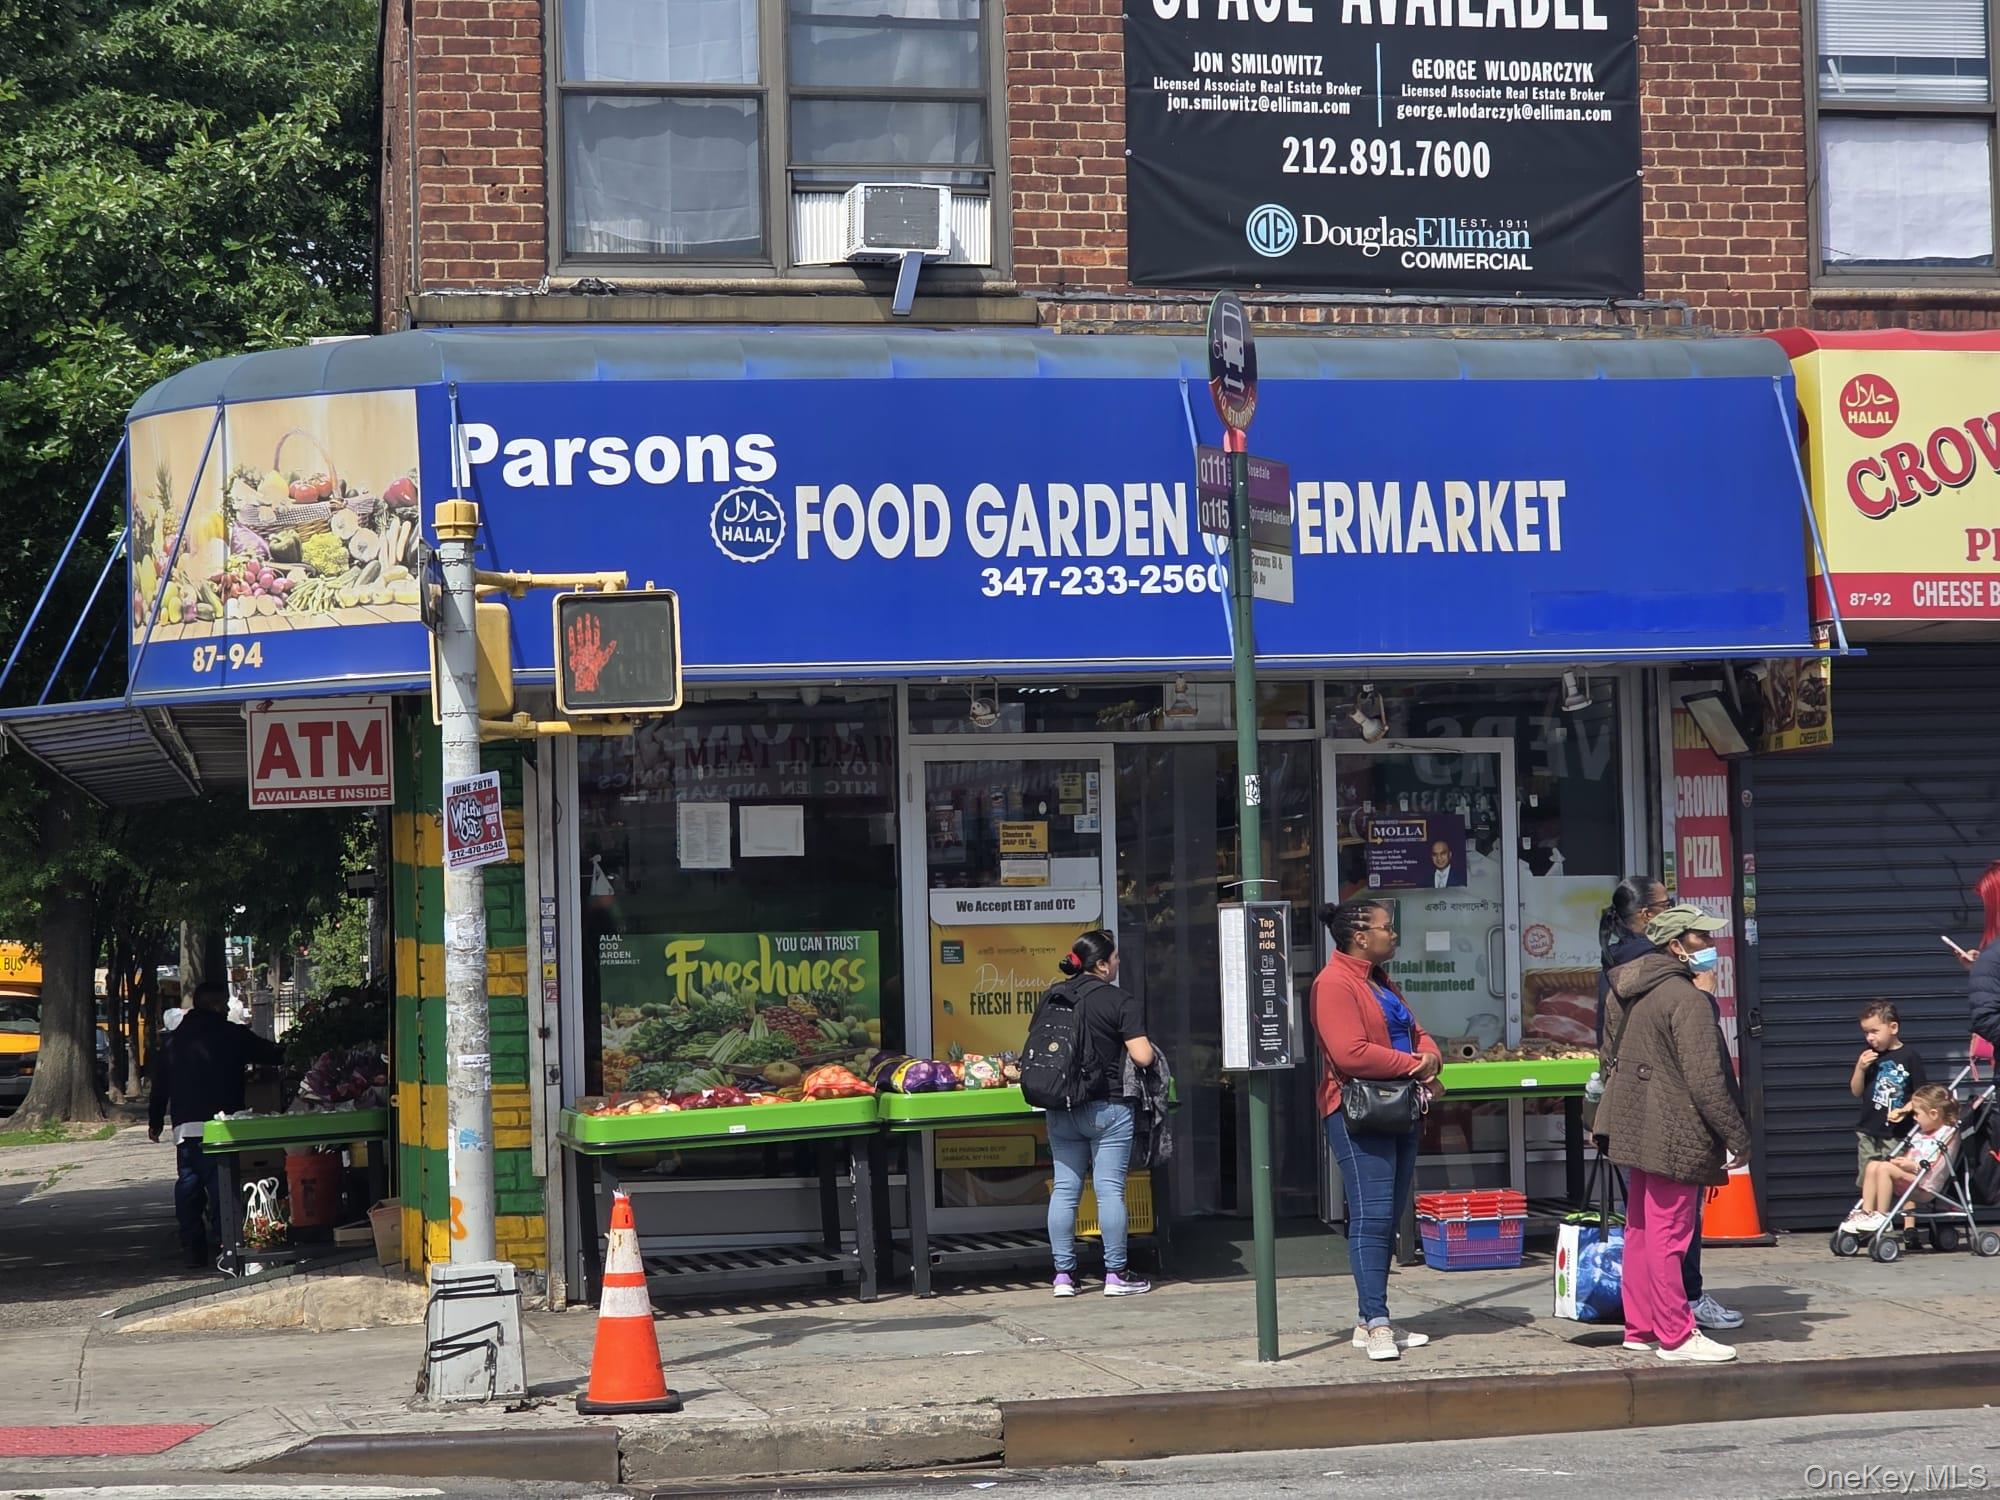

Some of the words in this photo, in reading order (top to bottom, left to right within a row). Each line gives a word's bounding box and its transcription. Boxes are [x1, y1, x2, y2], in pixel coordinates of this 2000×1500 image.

[1192, 52, 1223, 73] JON
[1231, 53, 1323, 76] SMILOWITZ
[1412, 58, 1477, 80] GEORGE
[1485, 60, 1594, 83] WLODARCZYK
[1153, 76, 1200, 91] Licensed
[1204, 78, 1257, 93] Associate
[1260, 80, 1283, 94] Real
[1287, 81, 1322, 95] Estate
[1326, 82, 1362, 96] Broker
[1401, 84, 1447, 98] Licensed
[1451, 85, 1501, 99] Associate
[1506, 86, 1528, 100] Real
[1532, 87, 1566, 101] Estate
[1570, 88, 1605, 101] Broker
[1167, 93, 1350, 115] jon.smilowitz@elliman.com
[1396, 102, 1612, 122] george.wlodarczyk@elliman.com
[1282, 136, 1491, 179] 212.891.7600
[1460, 218, 1493, 228] EST.
[1499, 219, 1529, 229] 1911
[1400, 251, 1534, 271] COMMERCIAL
[1217, 385, 1228, 410] NO
[1847, 410, 1894, 424] HALAL
[449, 423, 777, 488] Parsons
[1200, 454, 1228, 487] Q111
[723, 495, 778, 523] حلال
[795, 482, 951, 561] FOOD
[965, 476, 1189, 559] GARDEN
[1202, 479, 1567, 555] ERMARKET
[1201, 497, 1231, 530] Q115
[721, 525, 775, 543] HALAL
[980, 564, 1229, 597] 347-233-2560
[1849, 592, 1892, 606] 87-92
[1912, 580, 1984, 607] CHEESE
[192, 641, 264, 673] 87-94
[256, 720, 384, 780] ATM
[256, 789, 336, 802] AVAILABLE
[340, 787, 389, 799] INSIDE
[453, 783, 471, 795] JUNE
[1674, 775, 1728, 818] CROWN
[1373, 826, 1423, 837] MOLLA
[1683, 836, 1723, 878] PIZZA
[956, 900, 974, 913] We
[975, 899, 1012, 913] Accept
[1013, 899, 1033, 912] EBT
[1034, 899, 1053, 911] and
[1055, 898, 1076, 911] OTC
[1258, 917, 1275, 930] Tap
[599, 934, 623, 942] ALAL
[775, 936, 797, 952] YOU
[800, 936, 822, 952] CAN
[824, 935, 861, 951] TRUST
[1259, 929, 1275, 939] and
[599, 942, 619, 950] OOD
[599, 950, 631, 960] ARDEN
[1259, 940, 1276, 950] ride
[4, 957, 24, 971] BUS
[665, 934, 866, 1003] Freshness
[1392, 960, 1423, 974] Halal
[1425, 960, 1456, 974] Meat
[1404, 978, 1476, 992] Guaranteed
[970, 991, 1012, 1016] FRESH
